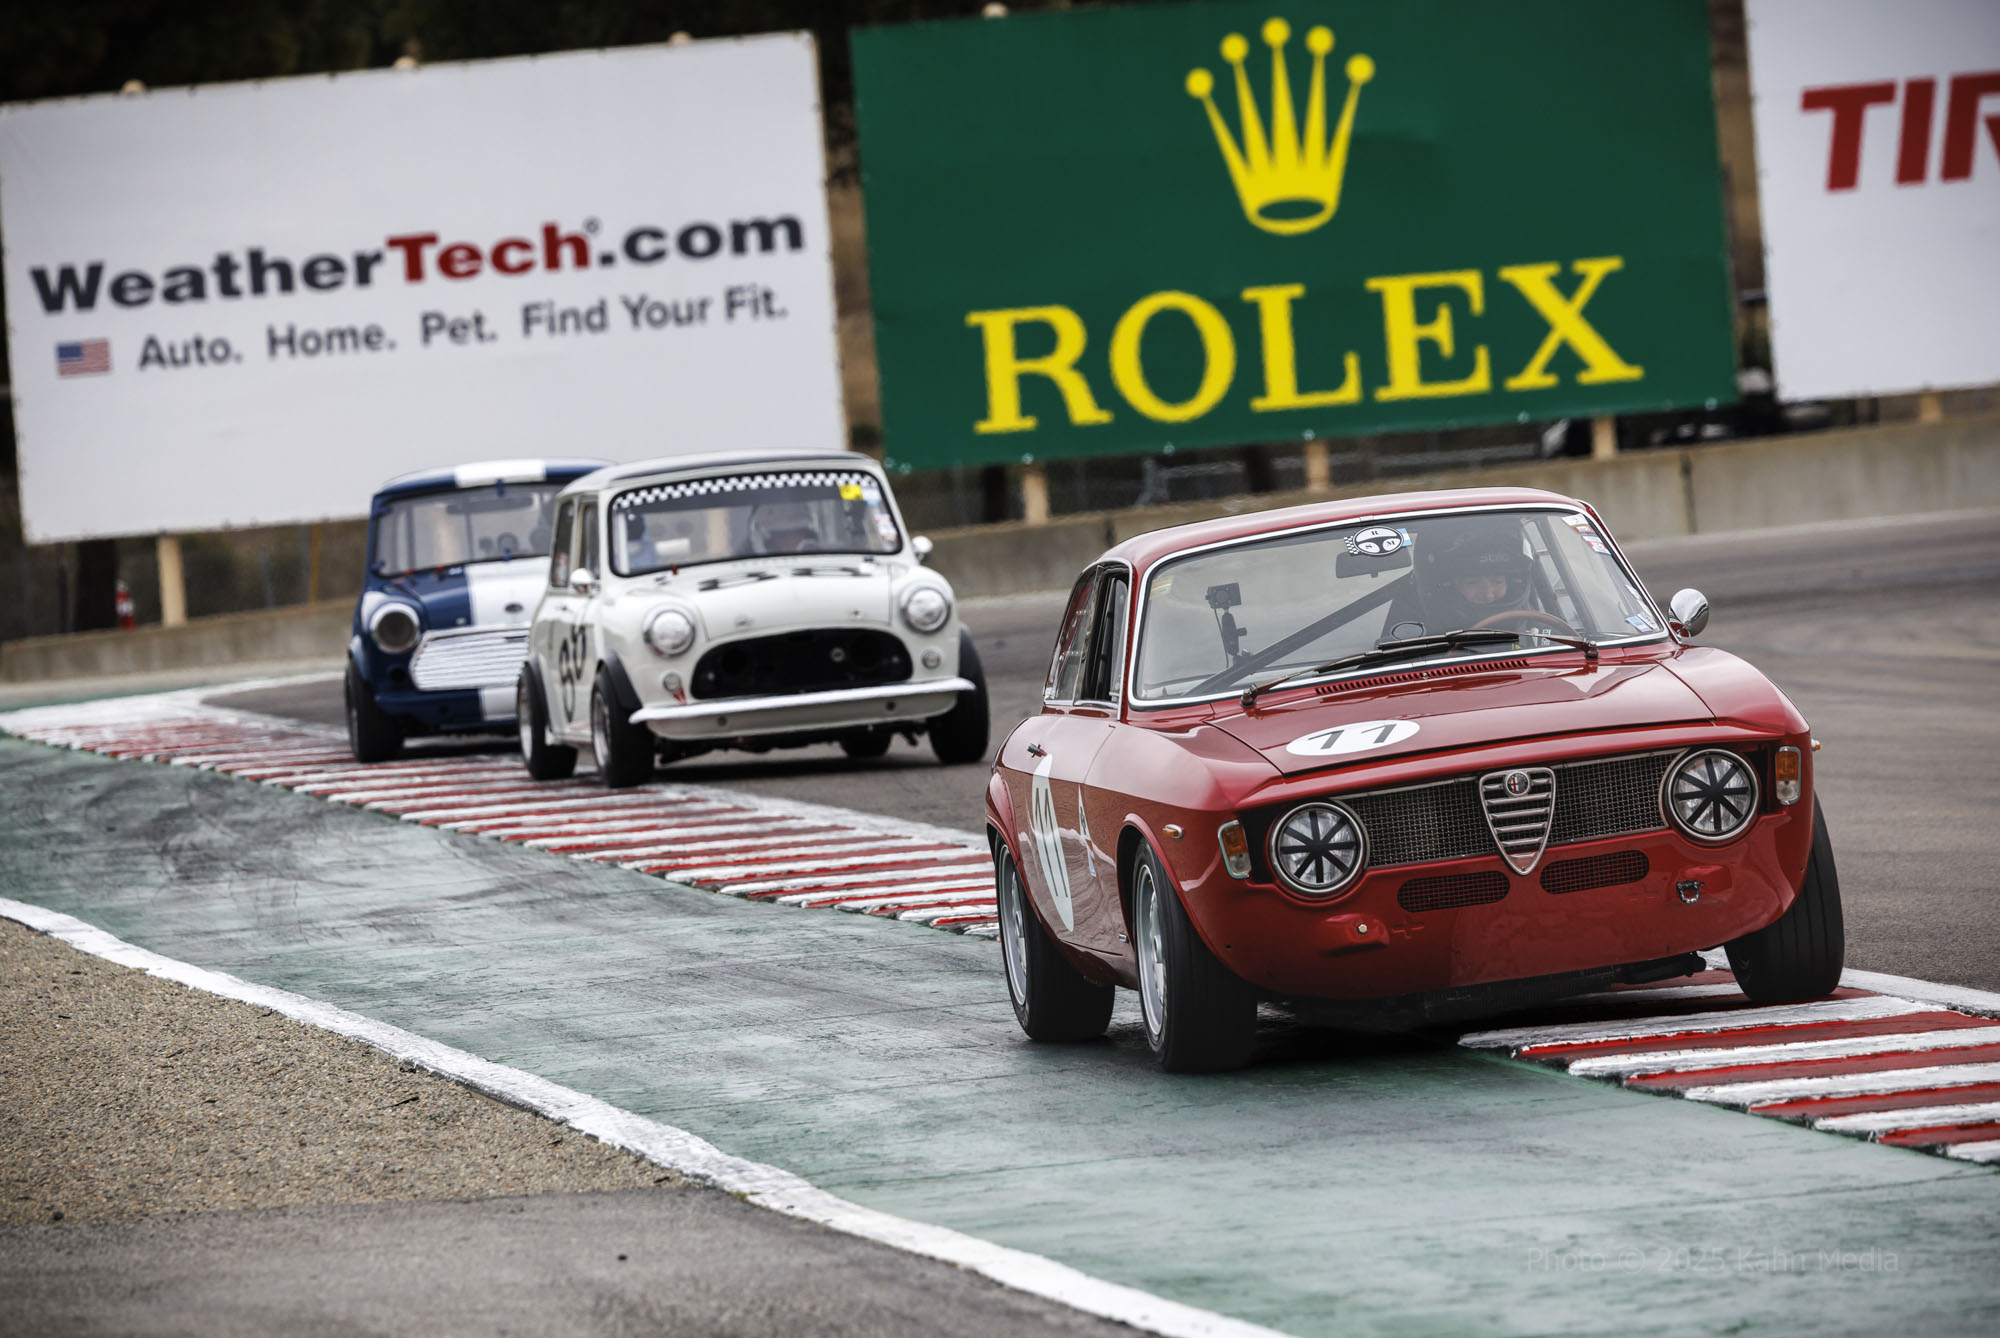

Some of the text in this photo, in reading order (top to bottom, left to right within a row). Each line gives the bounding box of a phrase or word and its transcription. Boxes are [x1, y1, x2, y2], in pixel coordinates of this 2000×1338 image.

[137, 285, 789, 371] Auto. Home. Pet. Find Your Fit.
[966, 257, 1645, 434] ROLEX
[1307, 723, 1397, 750] 11
[1035, 787, 1069, 898] 11
